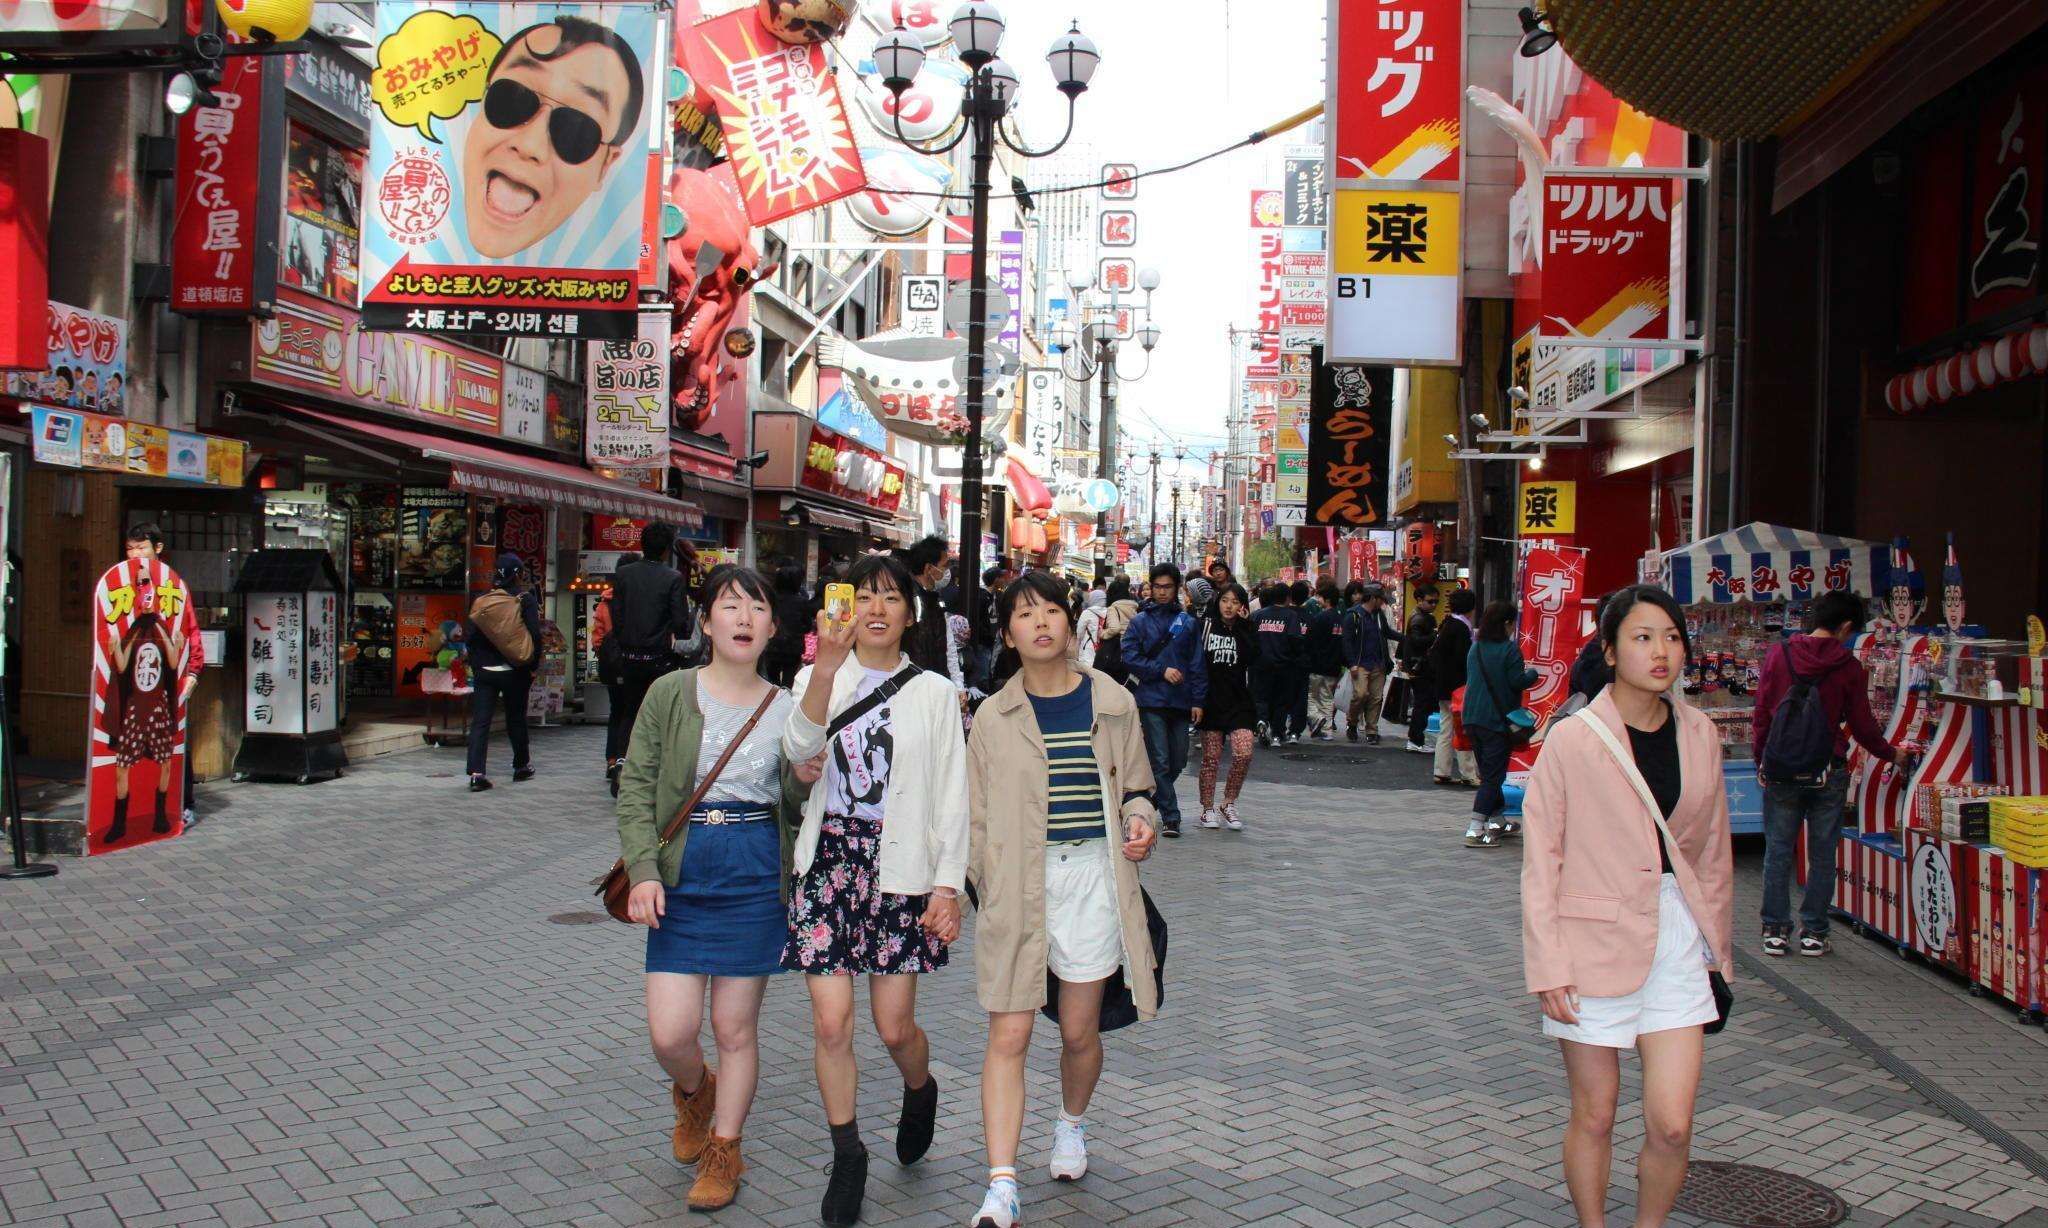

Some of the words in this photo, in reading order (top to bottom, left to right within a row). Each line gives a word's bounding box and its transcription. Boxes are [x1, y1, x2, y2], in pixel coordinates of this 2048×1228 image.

[382, 30, 480, 94] おみやげ
[1367, 0, 1434, 118] ッグ
[730, 63, 794, 193] ミュージアム
[762, 53, 820, 180] コナモン
[393, 146, 442, 162] よしもと
[1549, 184, 1667, 222] ツルハ
[1366, 203, 1427, 264] 薬
[1549, 230, 1645, 255] ドラッグ
[182, 286, 243, 303] 道頓堀店
[387, 274, 629, 300] よしもと芸人グッズ・大阪みやげ
[1337, 278, 1371, 299] B1
[547, 313, 580, 333] 선물
[345, 321, 457, 417] GAME
[594, 363, 663, 391] 旨い店
[457, 378, 499, 406] NIKO-NIKO
[1316, 408, 1377, 524] らーめん
[1525, 486, 1558, 528] 薬
[1706, 559, 1853, 594] 大阪みやげ
[1213, 649, 1238, 664] CITY
